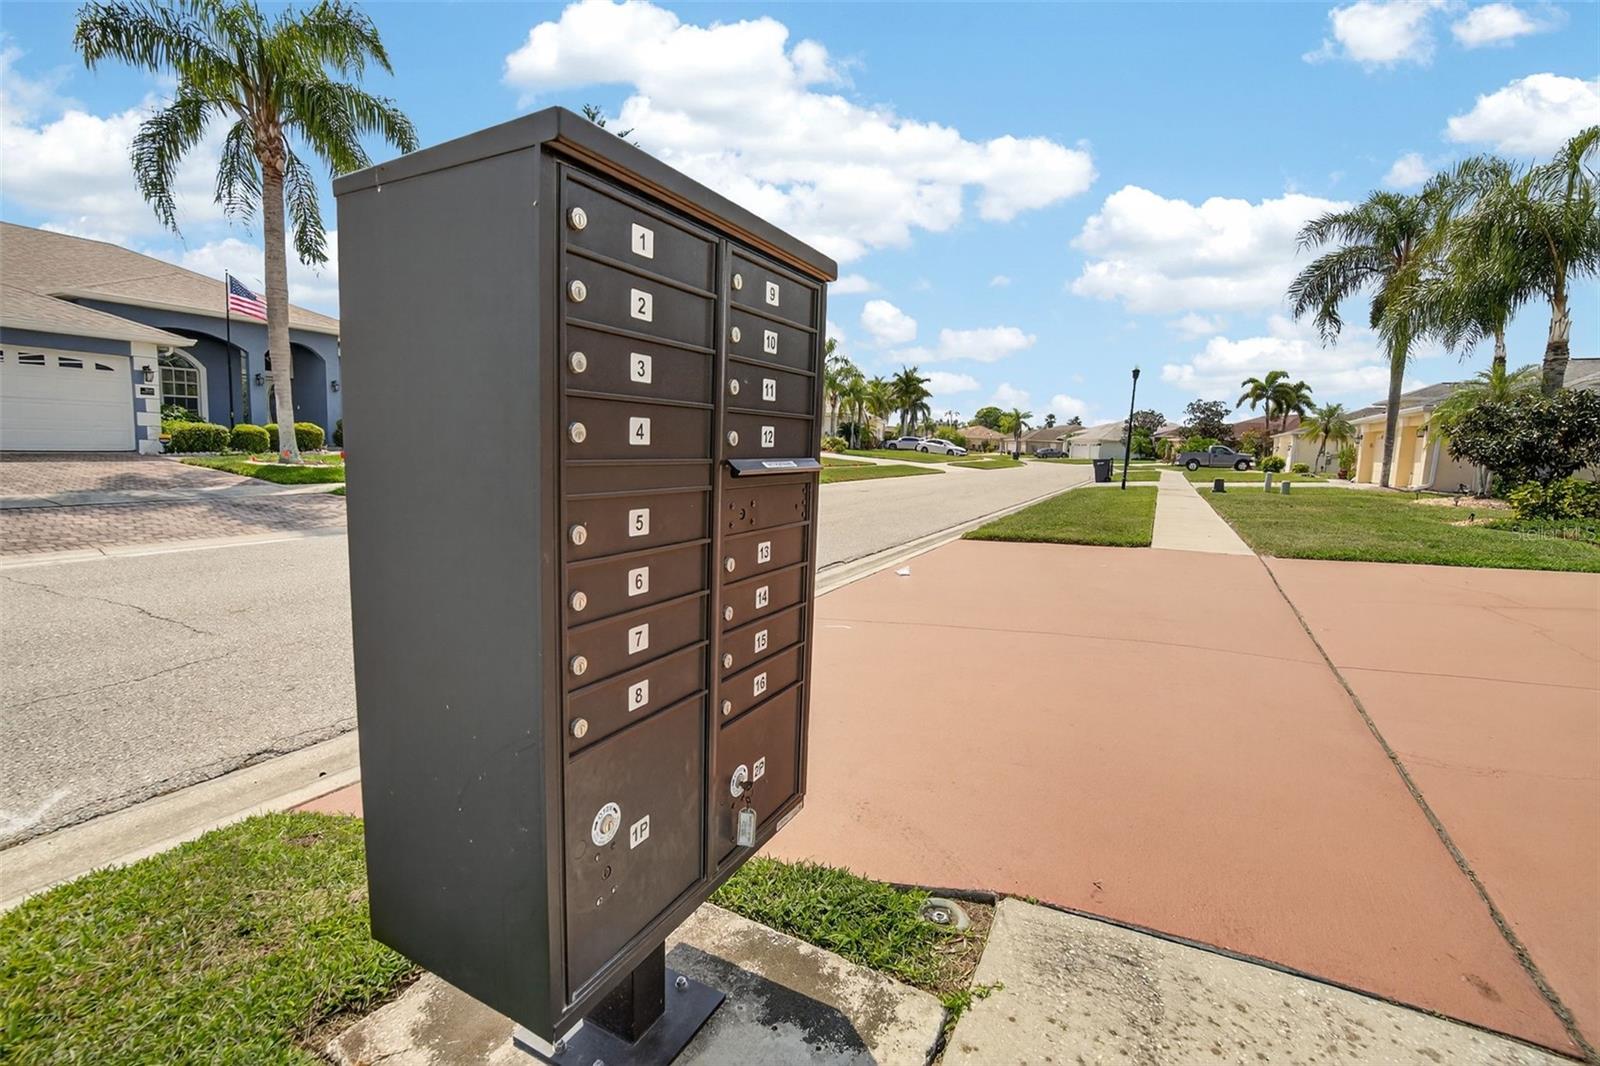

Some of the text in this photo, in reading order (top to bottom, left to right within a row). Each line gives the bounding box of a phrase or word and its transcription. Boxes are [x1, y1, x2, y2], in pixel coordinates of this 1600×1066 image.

[639, 233, 645, 251] 1
[770, 287, 776, 301] 9
[638, 297, 646, 315] 2
[766, 335, 776, 350] 10
[637, 360, 646, 377] 3
[765, 383, 774, 397] 11
[635, 423, 644, 440] 4
[763, 430, 773, 444] 12
[635, 514, 644, 531] 5
[760, 545, 769, 559] 13
[635, 573, 643, 590] 6
[758, 590, 767, 604] 14
[635, 630, 643, 647] 7
[757, 634, 766, 648] 15
[756, 676, 765, 691] 16
[635, 687, 643, 704] 8
[754, 761, 764, 778] 2P
[632, 821, 648, 842] 1P
